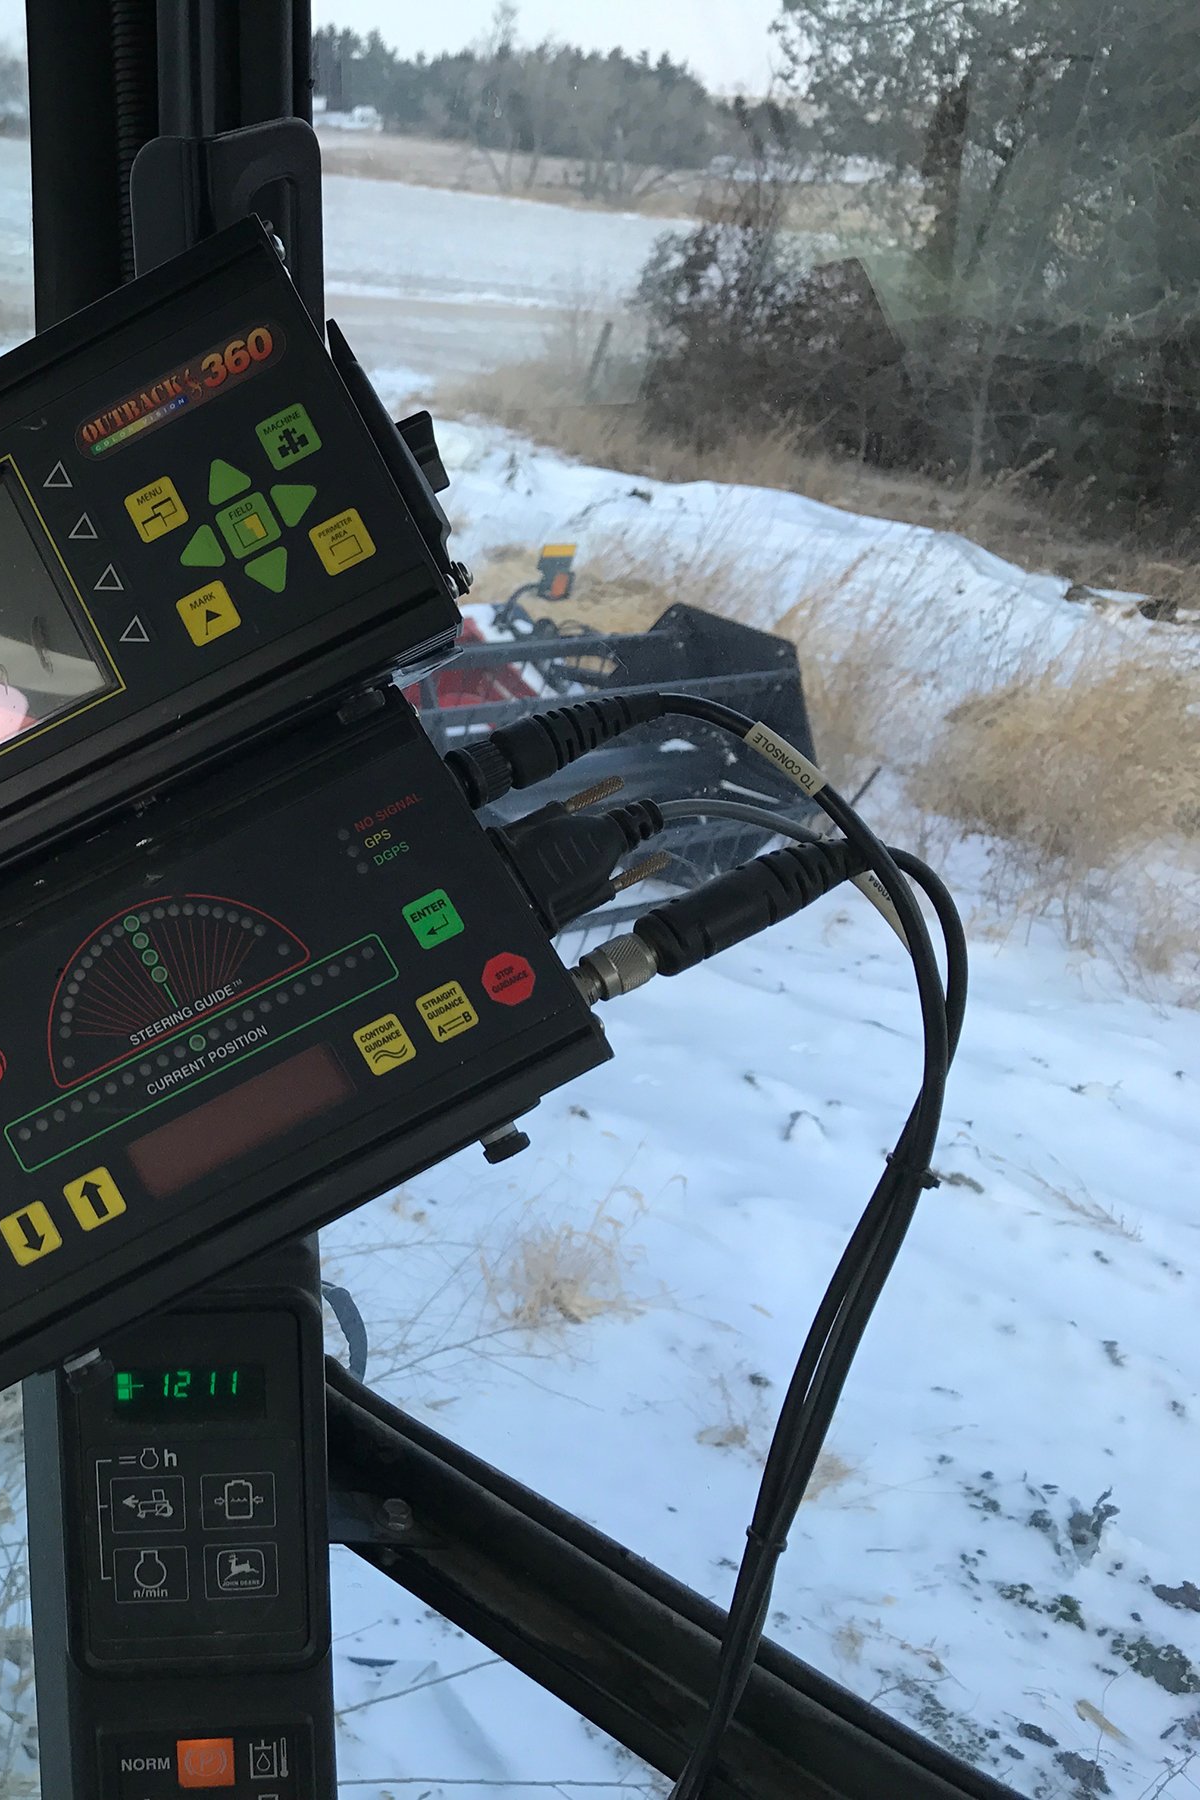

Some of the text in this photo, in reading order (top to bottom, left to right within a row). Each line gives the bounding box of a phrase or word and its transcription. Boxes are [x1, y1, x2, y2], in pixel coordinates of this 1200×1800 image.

[82, 327, 273, 443] OUTBACK 360
[143, 398, 186, 425] VISION
[263, 410, 301, 437] MACHINE
[136, 486, 163, 506] MENU
[228, 502, 254, 521] FIELD
[317, 516, 353, 539] PERIMETER
[330, 529, 348, 543] AREA
[189, 592, 216, 611] MARK
[752, 732, 815, 791] TO CONSOLE
[353, 792, 424, 833] NO SIGNAL
[364, 828, 392, 849] GPS
[373, 841, 410, 866] DGPS
[410, 898, 447, 924] ENTER
[421, 986, 458, 1011] STRAIGHT
[427, 996, 465, 1021] GUIDANCE
[129, 1006, 194, 1046] STEERING
[359, 1020, 396, 1044] CONTOUR
[364, 1029, 402, 1054] GUIDANCE
[146, 1025, 269, 1096] CURRENT POSITION
[133, 1587, 168, 1599] n/min
[121, 1757, 171, 1772] NORM
